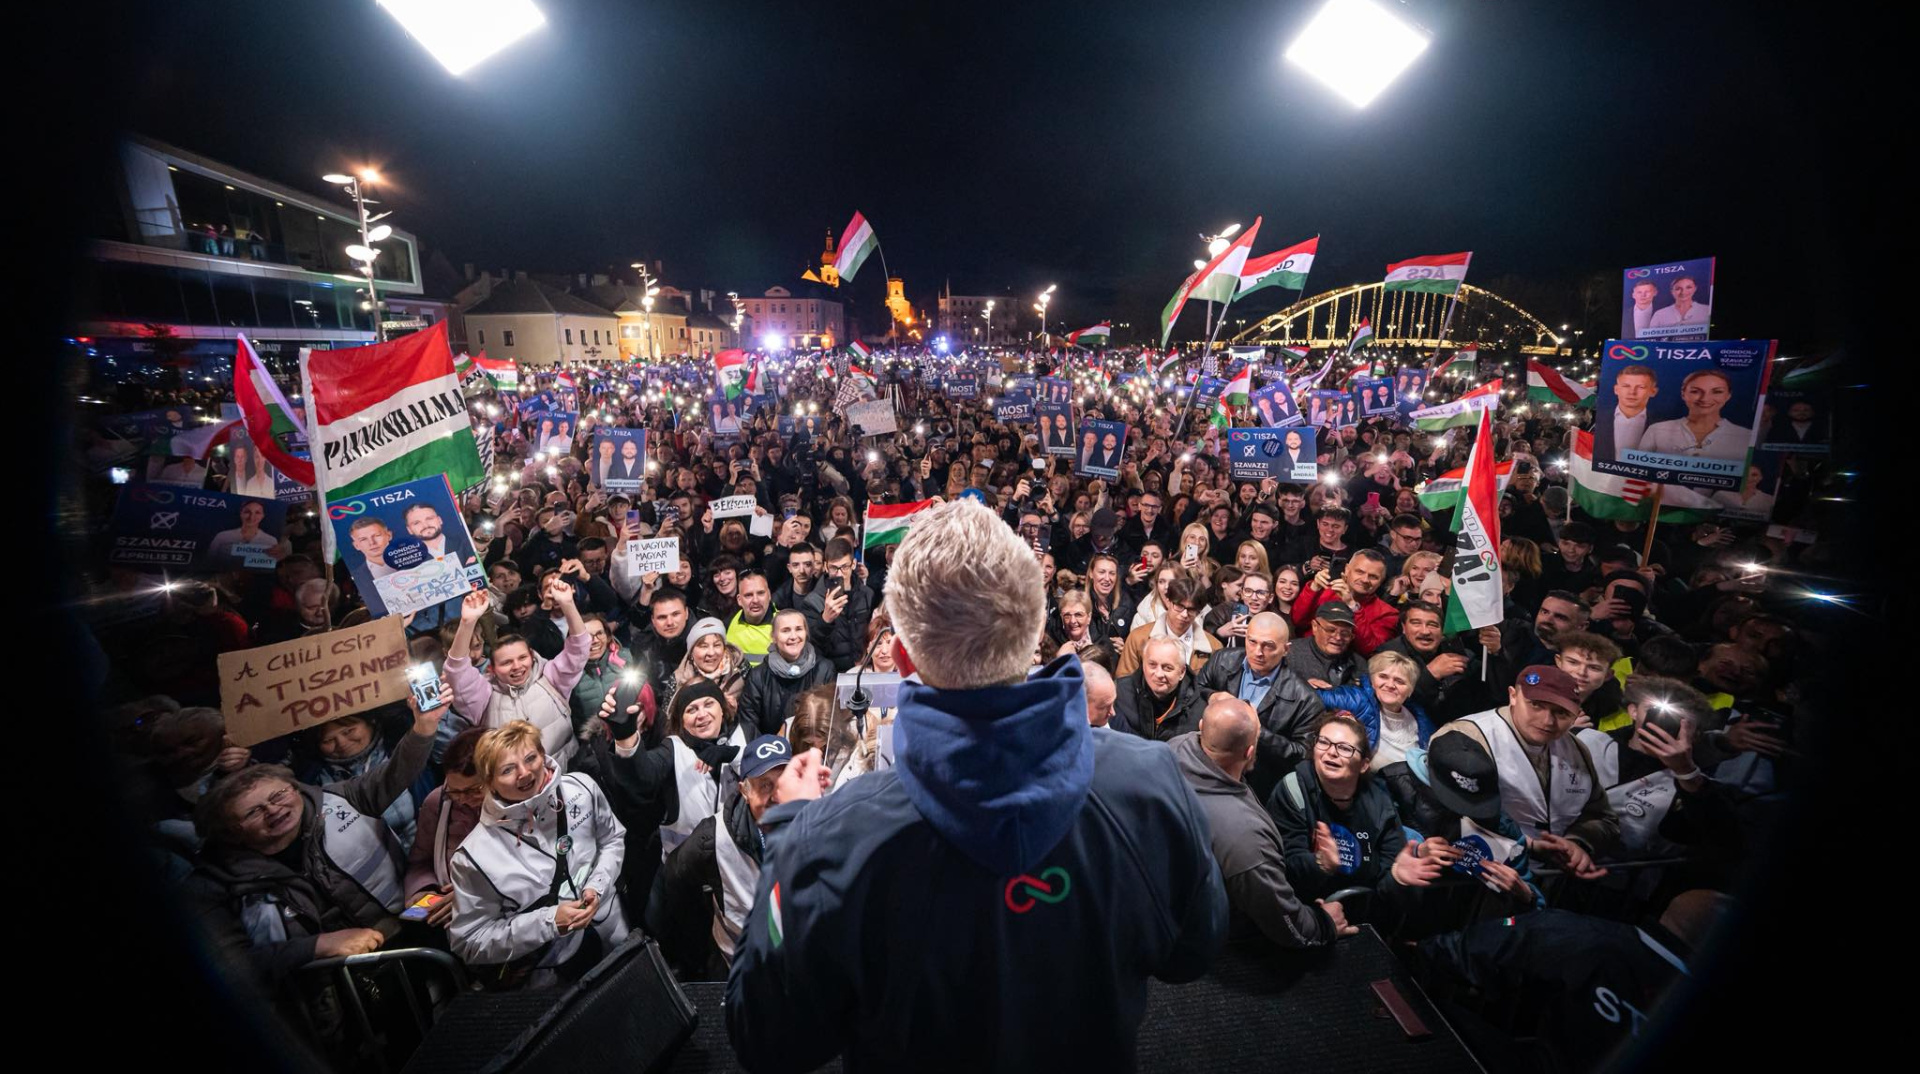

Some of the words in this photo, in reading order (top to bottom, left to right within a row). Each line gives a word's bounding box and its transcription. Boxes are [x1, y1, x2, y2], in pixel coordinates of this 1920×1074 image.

[1654, 265, 1685, 275] TISZA
[1656, 347, 1712, 360] TISZA
[950, 385, 974, 393] MOST
[1262, 385, 1276, 393] TISZA
[997, 404, 1029, 415] MOST
[324, 388, 467, 470] PANNONHALMA
[1098, 422, 1114, 430] TISZA
[1597, 461, 1648, 477] SZAVAZZ!
[1626, 452, 1688, 469] DIÓSZEGI
[1691, 462, 1739, 473] JUDIT
[1681, 474, 1715, 485] ÁPRILIS
[182, 494, 227, 509] TISZA
[370, 488, 416, 507] TISZA
[116, 536, 197, 550] SZAVAZZ!
[388, 542, 420, 557] GONDOLJ
[641, 540, 677, 551] VAGYUNK
[117, 551, 168, 561] ÁPRILIS
[170, 552, 187, 562] 12.
[394, 552, 422, 565] SZAVAZZ
[636, 550, 667, 561] MAGYAR
[638, 560, 666, 571] PÉTER
[234, 692, 263, 714] A
[266, 664, 354, 701] TISZA
[281, 680, 380, 727] PONT!
[1593, 987, 1650, 1037] ST
